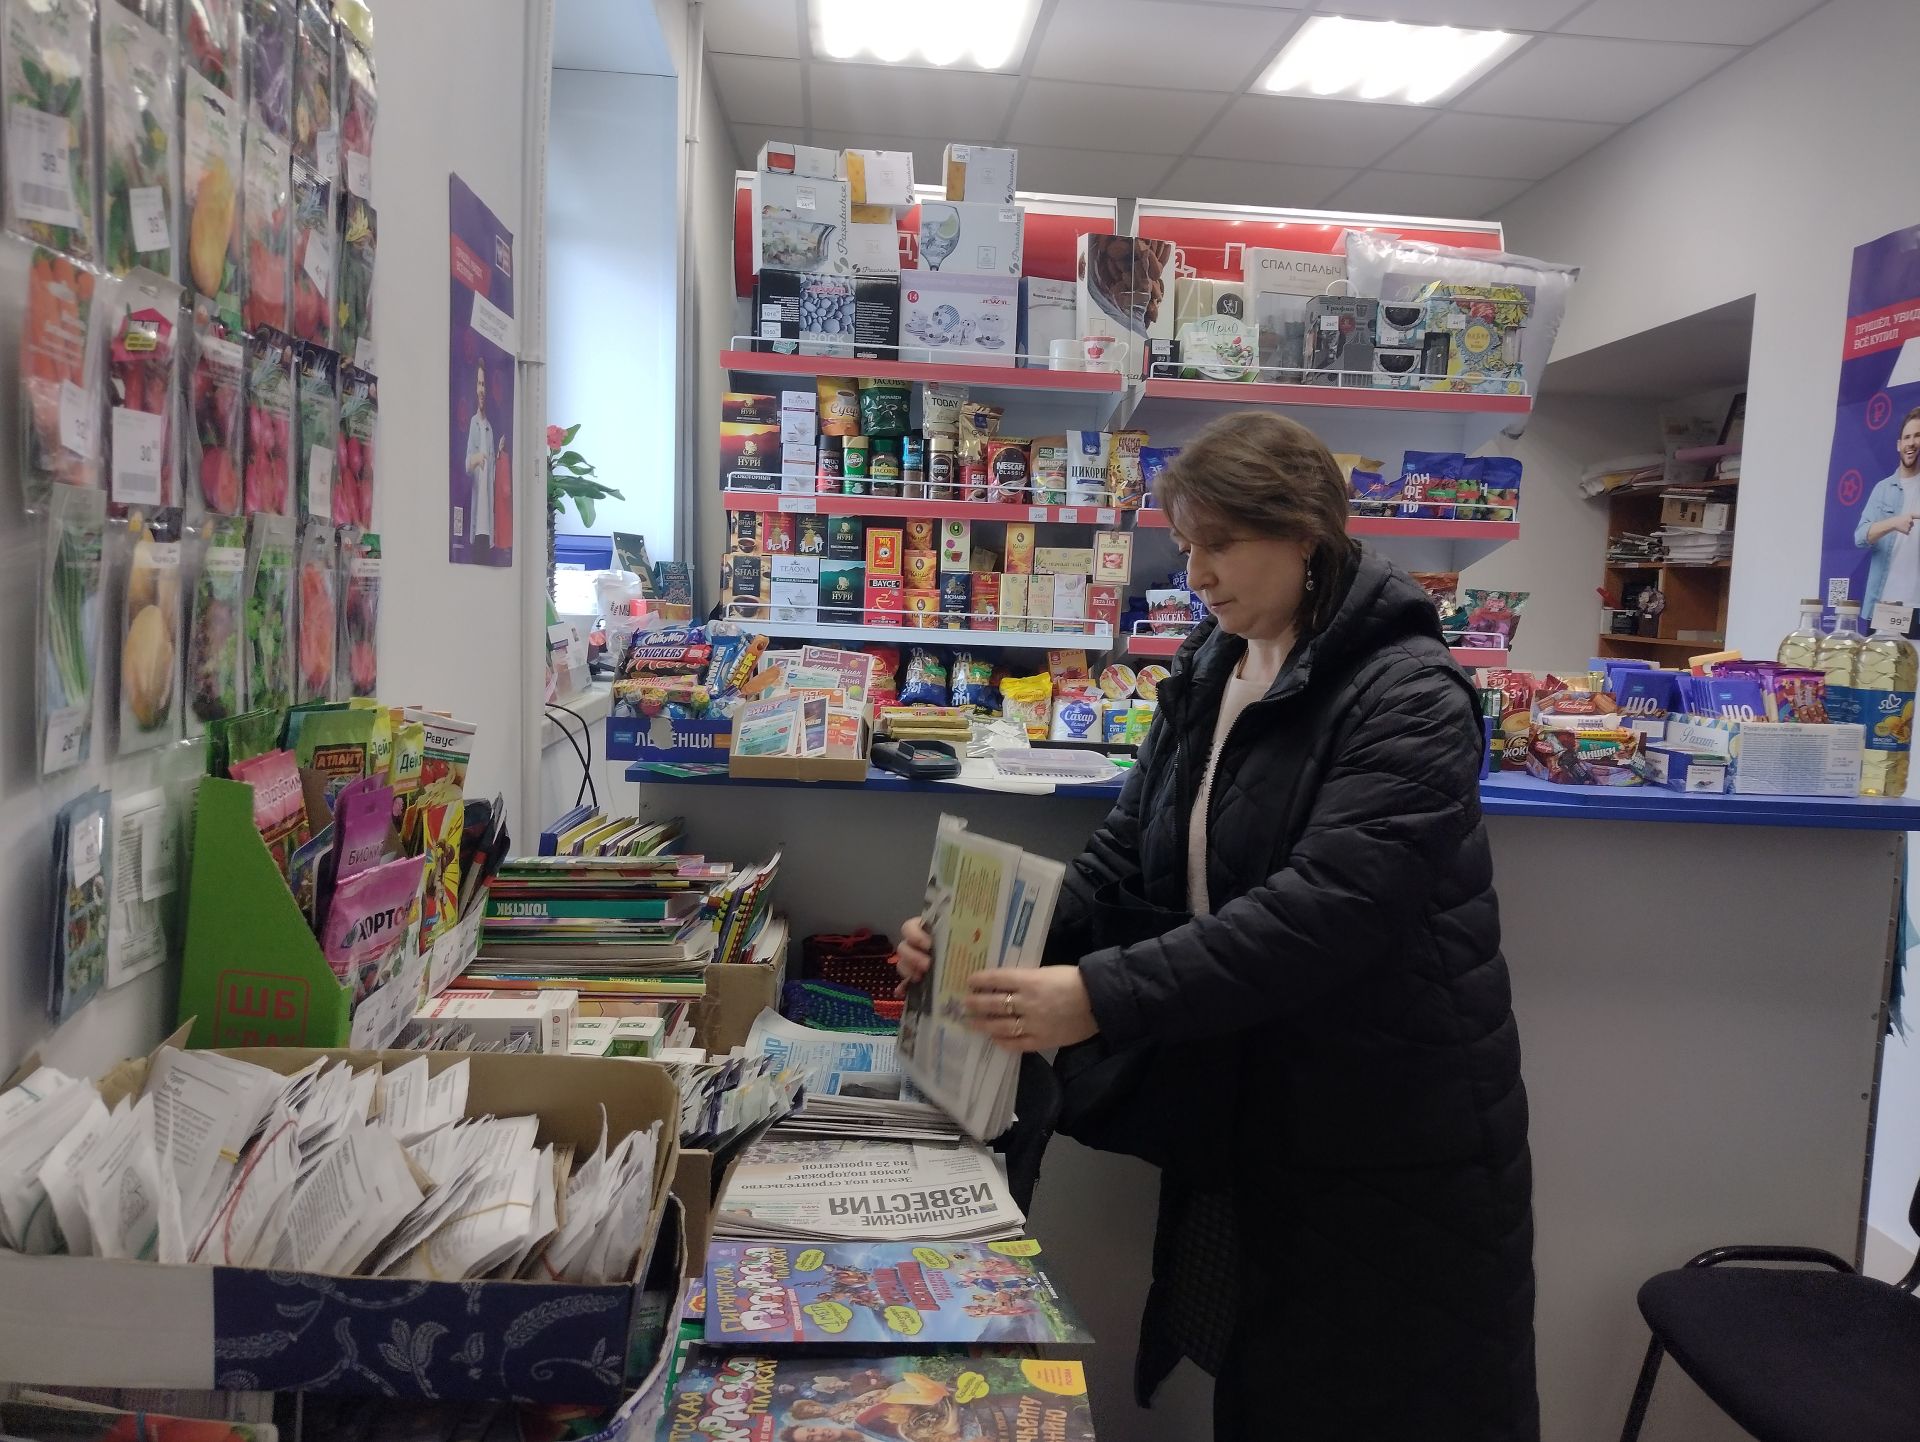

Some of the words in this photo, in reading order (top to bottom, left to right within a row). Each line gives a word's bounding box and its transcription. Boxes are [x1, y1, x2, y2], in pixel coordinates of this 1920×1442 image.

[1261, 259, 1292, 271] СПАЛ
[1295, 262, 1342, 276] СПАЛЫЧ
[931, 397, 959, 408] TODAY
[737, 459, 761, 467] НУРИ
[734, 568, 760, 576] SHAH
[635, 646, 685, 659] SNICKERS
[1557, 701, 1594, 711] Победа
[1064, 709, 1095, 723] Сахар
[634, 732, 713, 750] ЛЕНЦЫ
[1502, 746, 1529, 759] ЖОК
[317, 751, 364, 769] АТЛАНТ
[497, 902, 549, 916] ТОЛСТЯК
[801, 1160, 873, 1171] процентов
[786, 1170, 866, 1181] подорожает
[870, 1168, 911, 1177] домов
[741, 1180, 842, 1190] строительство
[844, 1178, 869, 1186] под
[872, 1176, 912, 1185] Земля
[828, 1182, 994, 1215] ИЗВЕСТИЯ
[860, 1205, 978, 1227] ЧЕЛНИНСКИЕ
[768, 1246, 790, 1280] ПЛАКАТ
[746, 1359, 778, 1414] ПЛАКАТ
